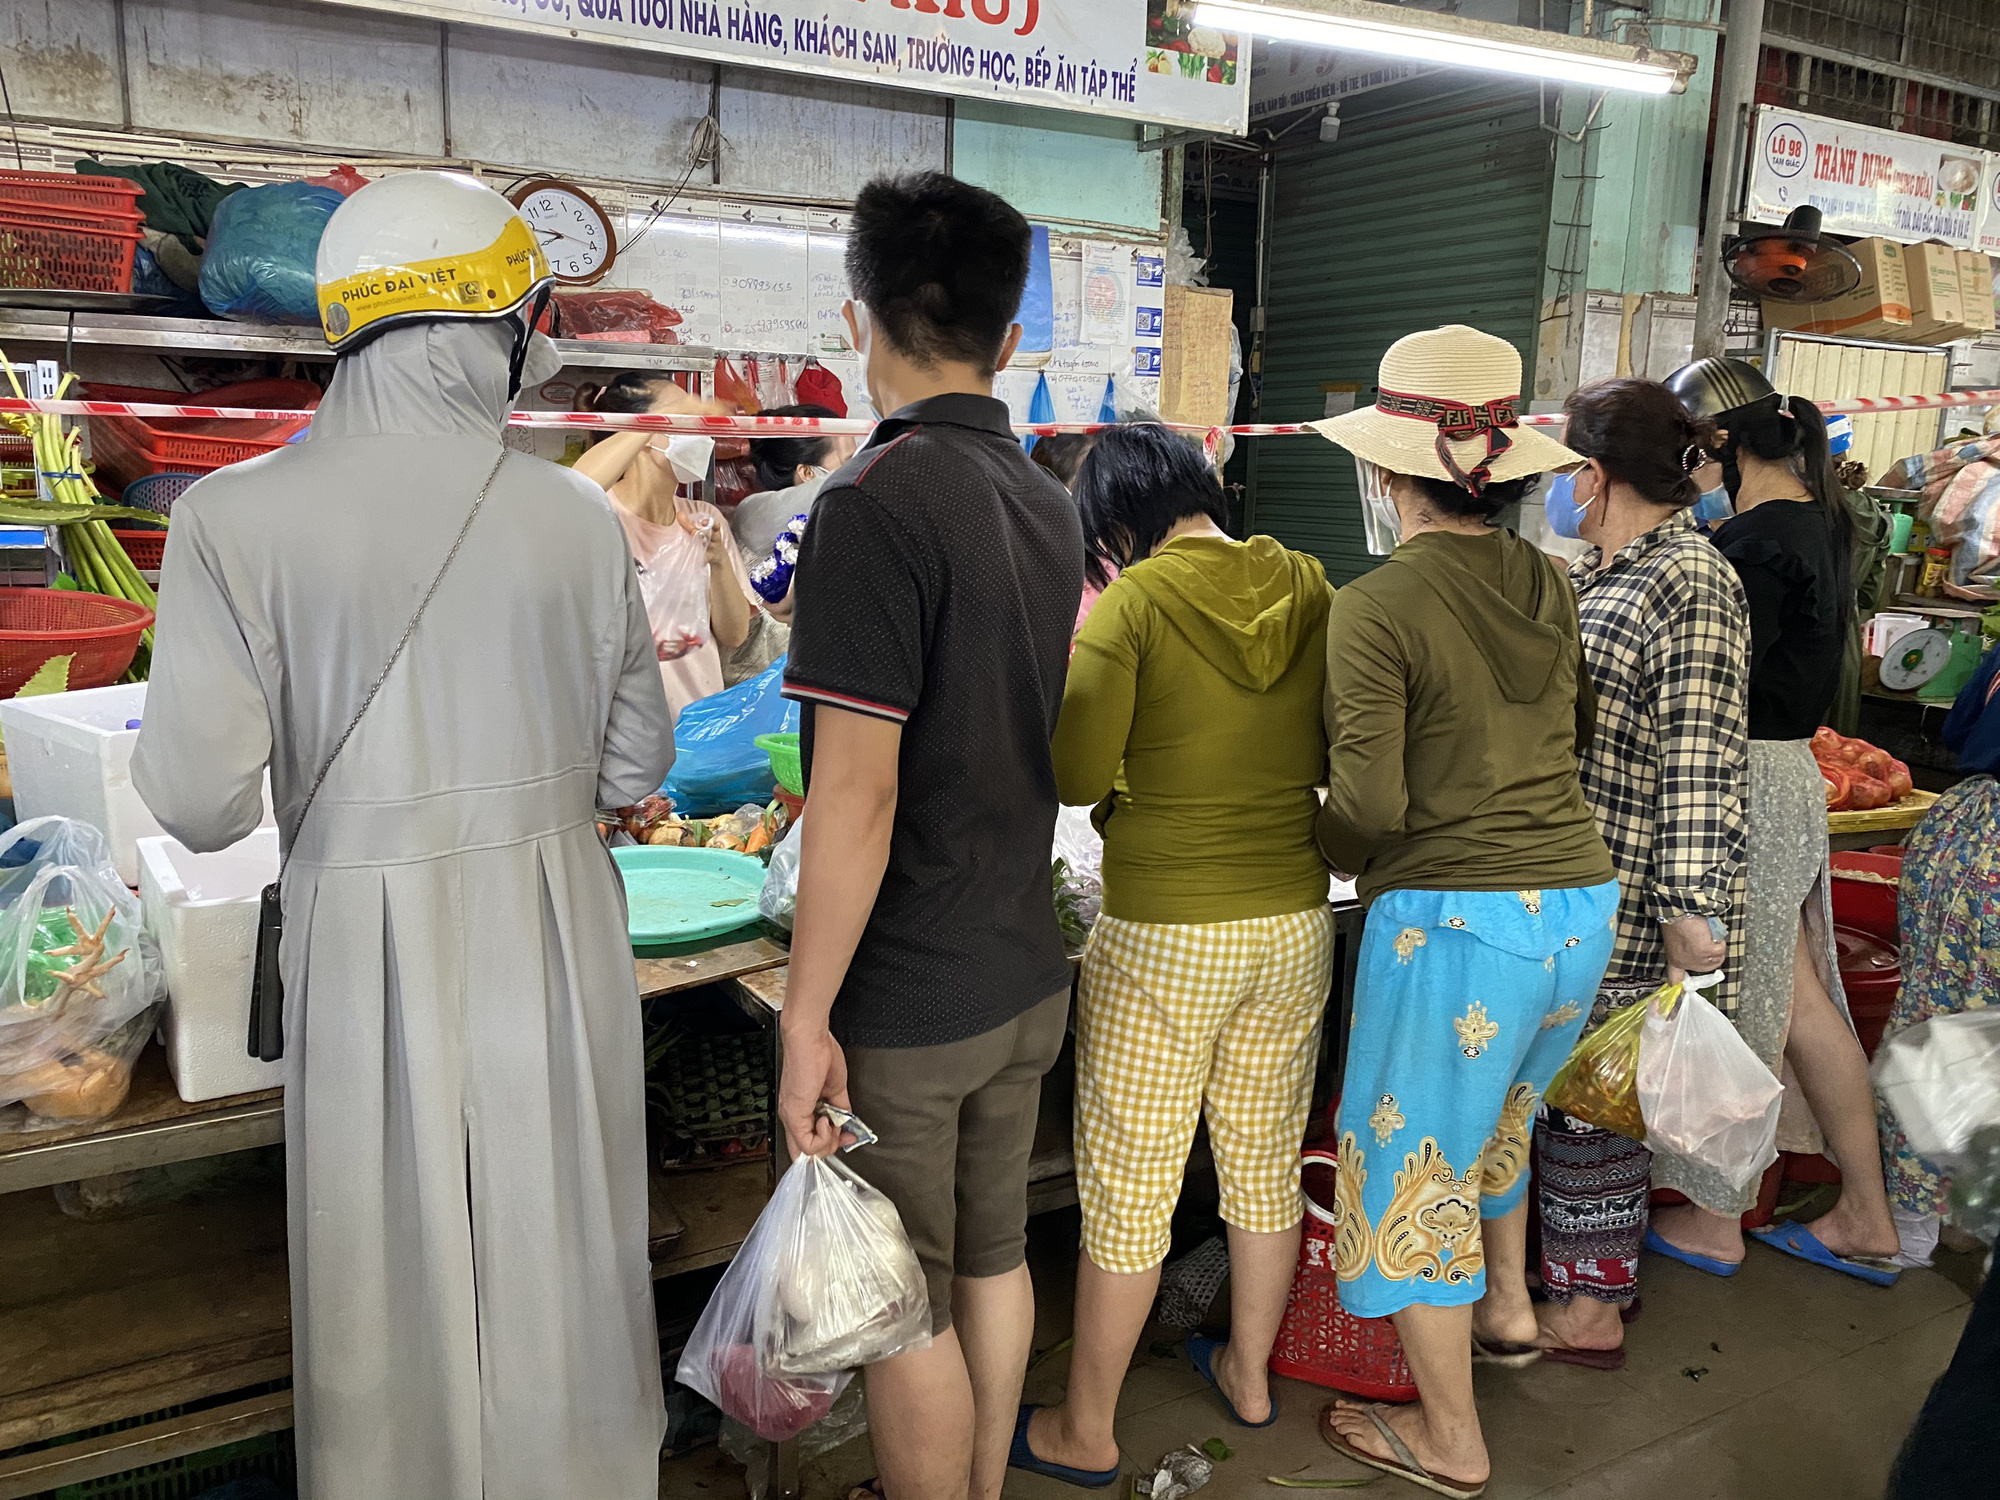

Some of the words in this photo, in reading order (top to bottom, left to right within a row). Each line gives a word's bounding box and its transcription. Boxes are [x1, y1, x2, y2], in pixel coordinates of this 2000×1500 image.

[727, 0, 788, 55] HÀNG,
[794, 14, 858, 59] KHÁCH
[862, 30, 902, 73] SẠN,
[906, 32, 976, 78] TRƯỜNG
[979, 49, 1020, 92] HỌC,
[1024, 46, 1051, 87] BẾP
[1055, 58, 1077, 94] ĂN
[1081, 65, 1109, 105] TẬP
[1111, 57, 1137, 103] THỂ
[1771, 134, 1786, 155] LÔ
[1788, 139, 1802, 158] 98
[1772, 156, 1784, 166] TAM
[1785, 157, 1801, 168] GIÁC
[539, 199, 554, 212] 12
[560, 201, 568, 213] 1
[527, 206, 540, 219] 11
[573, 209, 585, 222] 2
[584, 223, 595, 236] 3
[589, 240, 598, 252] 4
[582, 252, 593, 265] 5
[551, 259, 561, 272] 7
[569, 260, 580, 273] 6
[341, 282, 382, 303] PHÚC
[384, 276, 415, 294] ĐẠI
[418, 267, 457, 287] VIỆT
